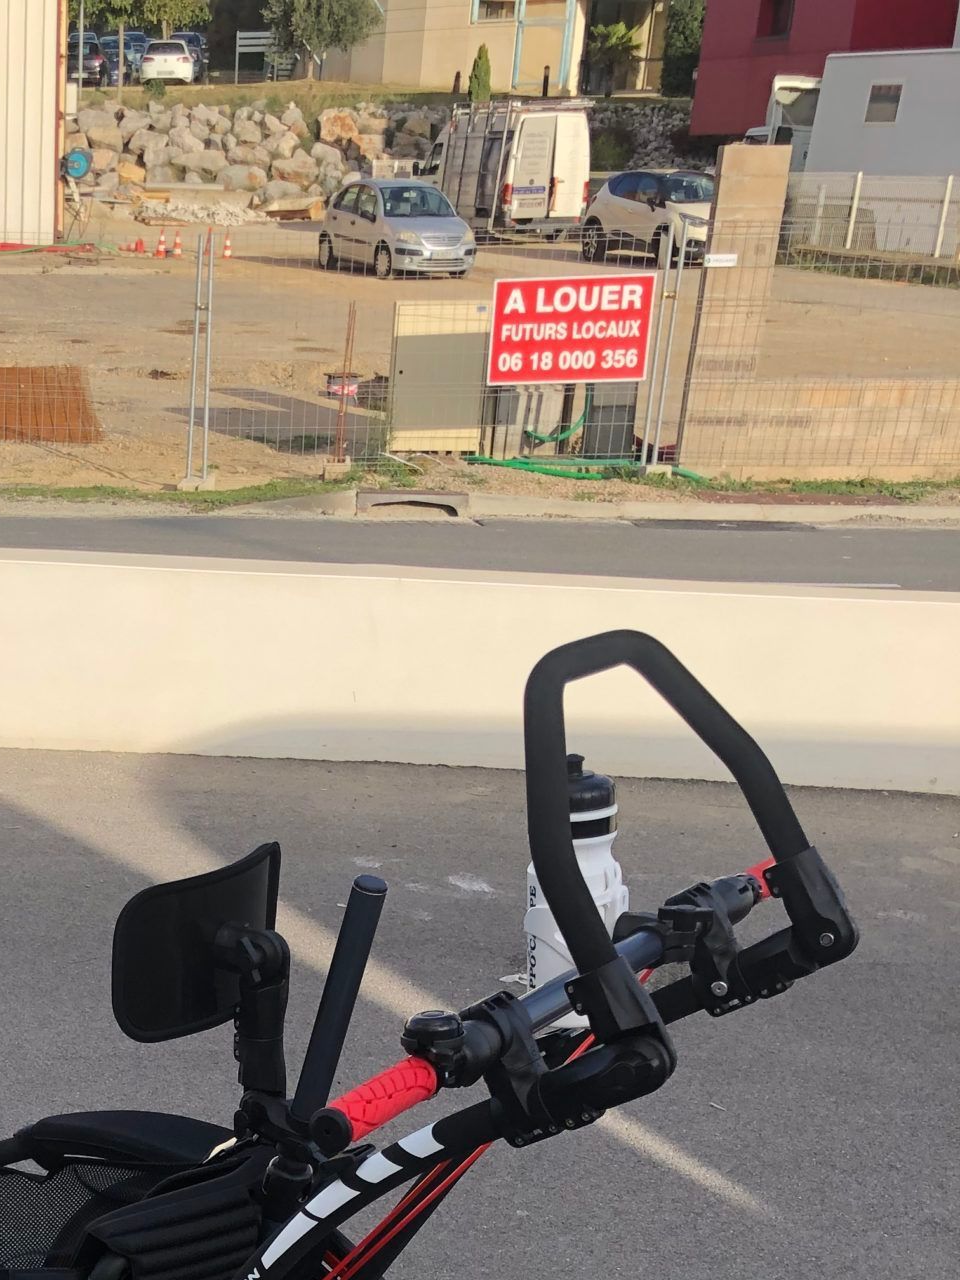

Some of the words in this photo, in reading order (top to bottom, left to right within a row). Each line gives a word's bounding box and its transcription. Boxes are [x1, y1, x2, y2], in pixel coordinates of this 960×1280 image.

[503, 287, 526, 314] A
[536, 284, 644, 313] LOUER
[501, 322, 568, 342] FUTURS
[572, 320, 641, 340] LOCAUX
[497, 352, 523, 372] 06
[530, 351, 553, 370] 18
[558, 350, 596, 370] 000
[601, 348, 639, 369] 356
